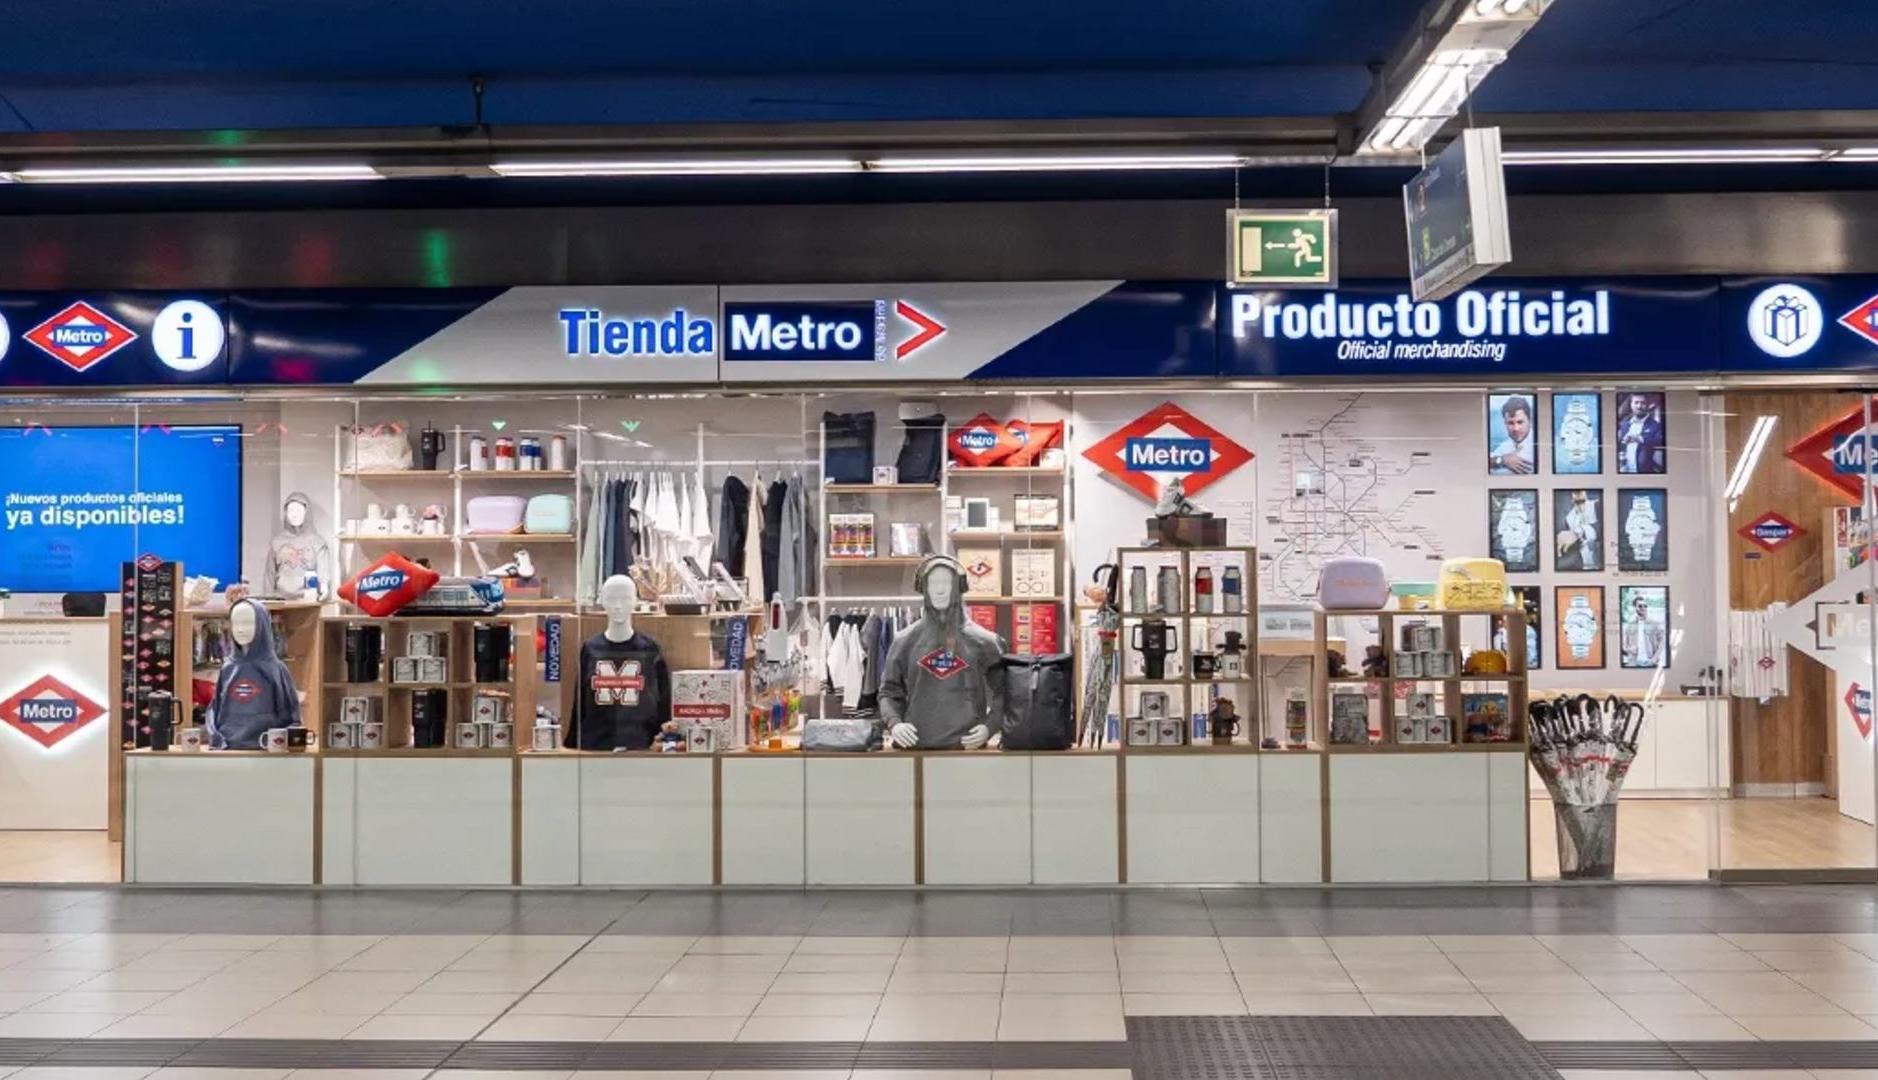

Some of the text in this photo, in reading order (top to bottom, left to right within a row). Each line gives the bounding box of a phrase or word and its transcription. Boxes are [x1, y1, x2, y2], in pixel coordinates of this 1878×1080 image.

[1231, 290, 1610, 339] Producto Oficial
[56, 328, 104, 345] Metro
[559, 309, 714, 355] Tienda
[730, 313, 862, 351] Metro
[1337, 339, 1508, 362] Official merchandising
[1131, 443, 1205, 467] Metro
[60, 492, 127, 506] productos
[129, 491, 183, 504] oficiales
[5, 504, 185, 531] ya disponibles!
[361, 575, 400, 591] Metro
[22, 702, 74, 719] Metro
